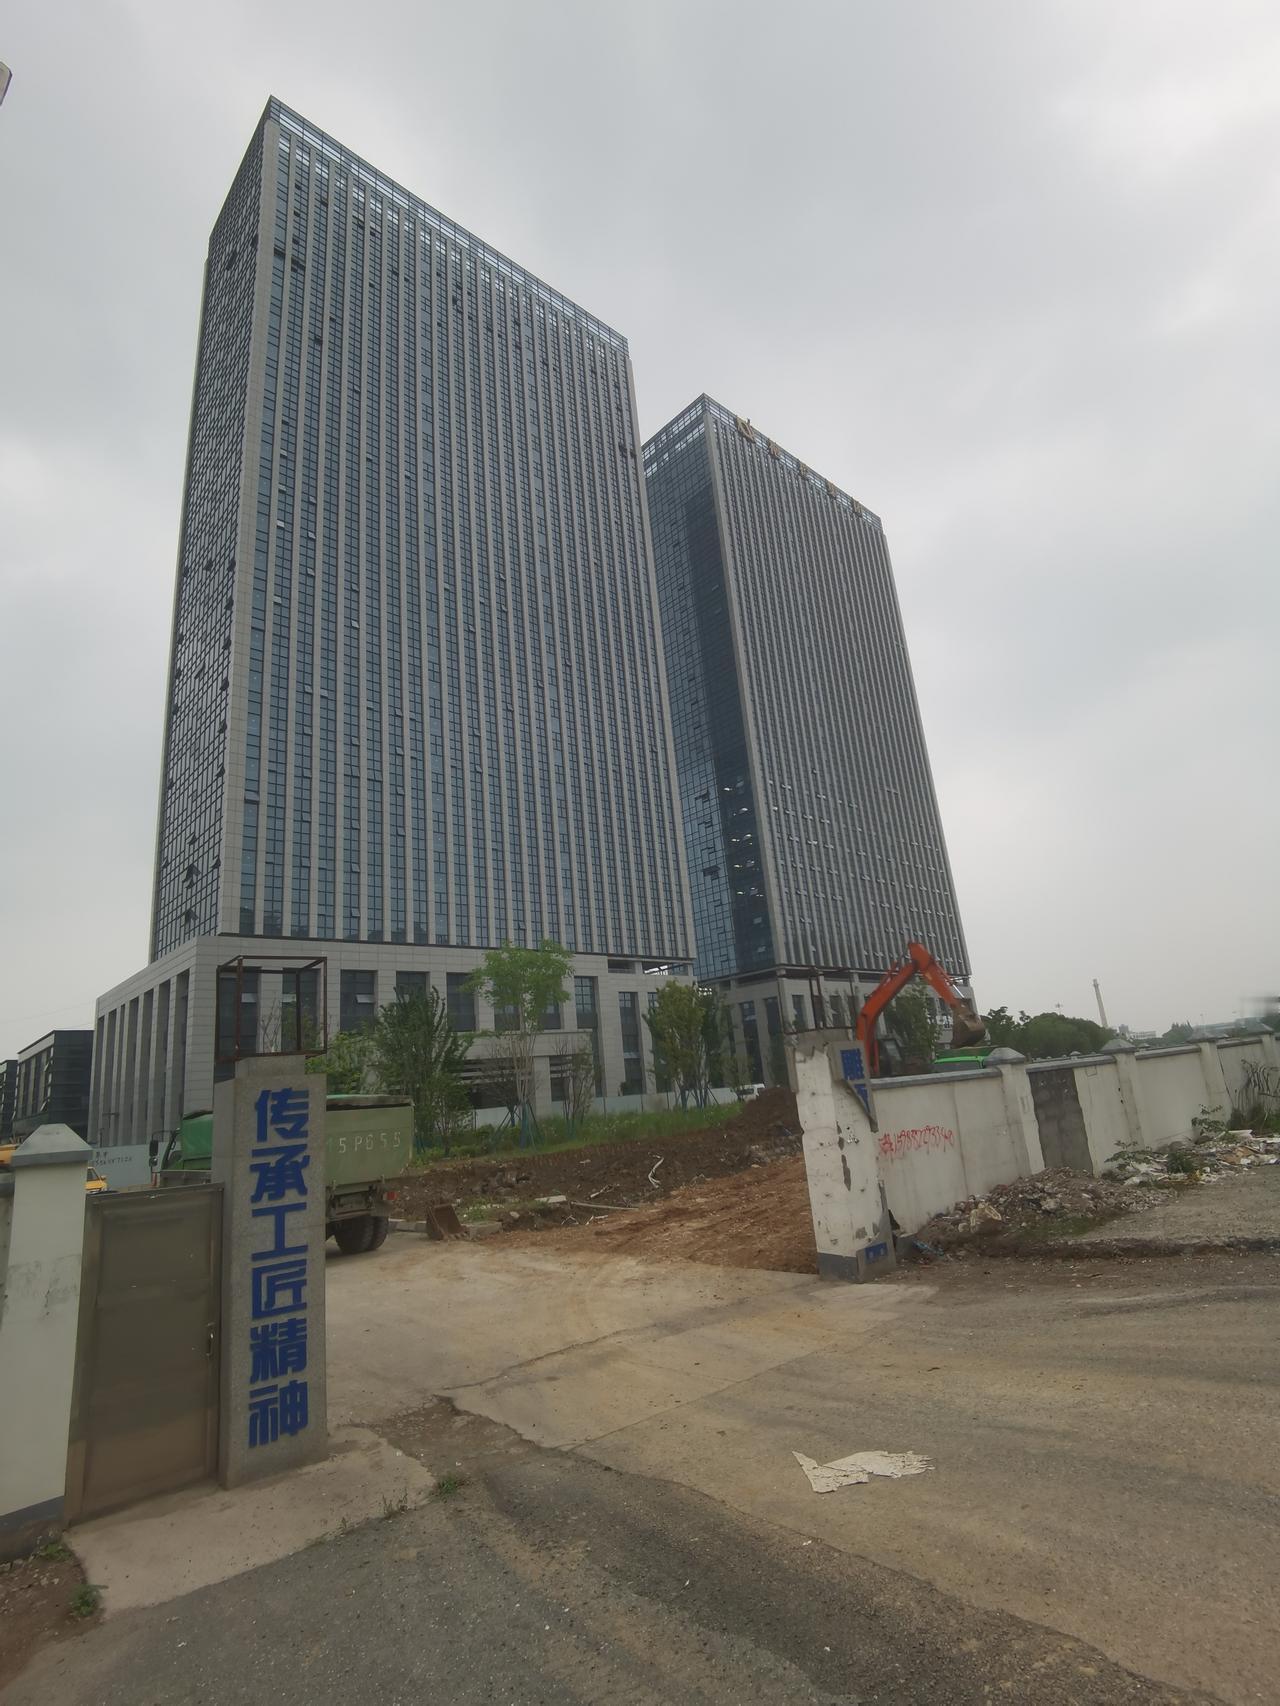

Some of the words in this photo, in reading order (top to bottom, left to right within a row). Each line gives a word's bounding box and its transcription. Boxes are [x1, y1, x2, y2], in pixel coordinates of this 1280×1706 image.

[249, 1086, 311, 1448] 传承工匠精神
